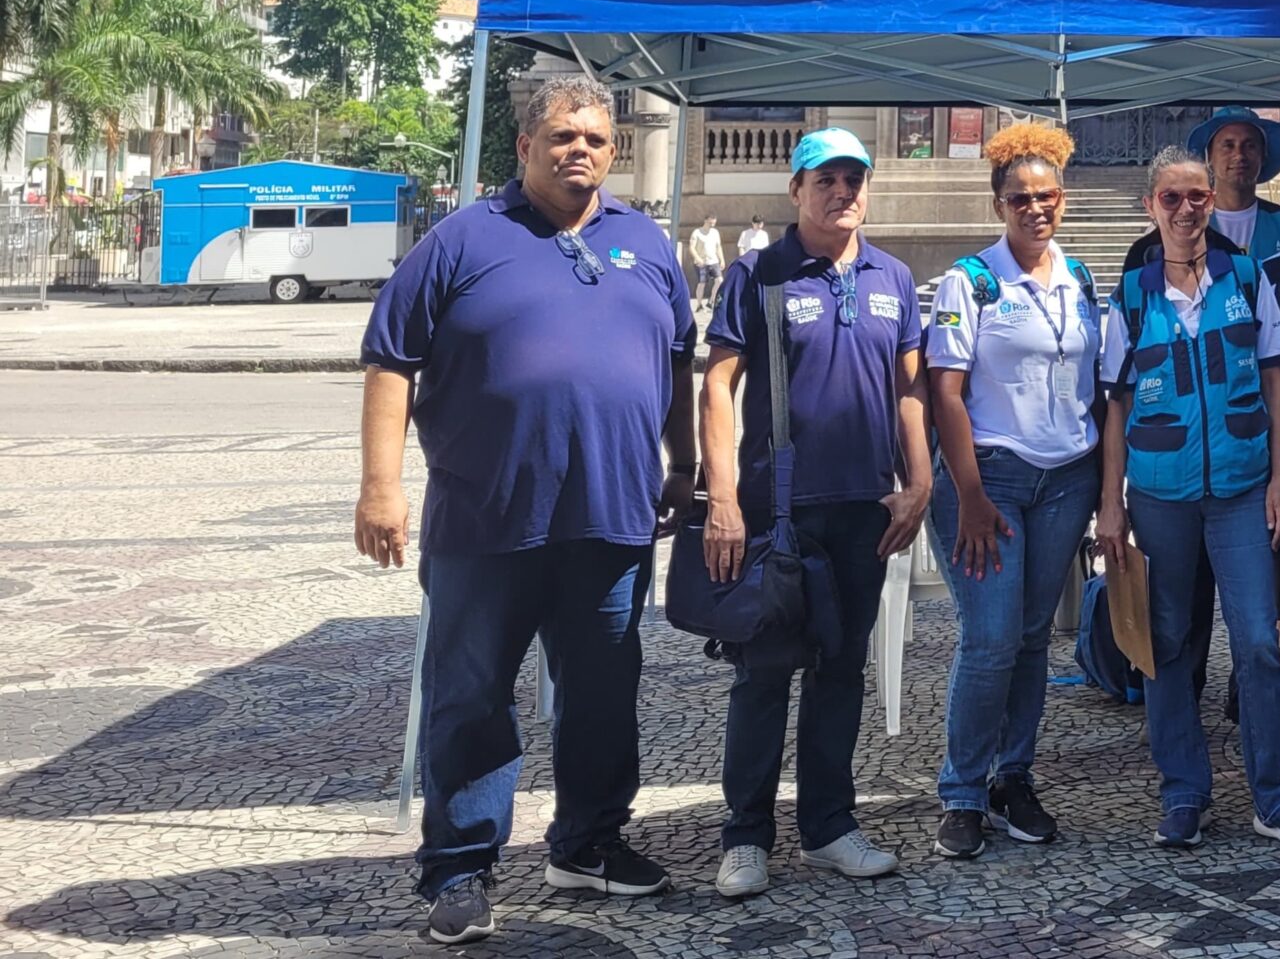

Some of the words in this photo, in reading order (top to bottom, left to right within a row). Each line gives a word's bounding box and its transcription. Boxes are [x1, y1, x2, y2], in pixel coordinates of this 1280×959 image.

[249, 185, 294, 194] POLÍCIA
[311, 184, 356, 193] MILITAR
[801, 297, 821, 309] Rio
[1012, 302, 1030, 311] Rio
